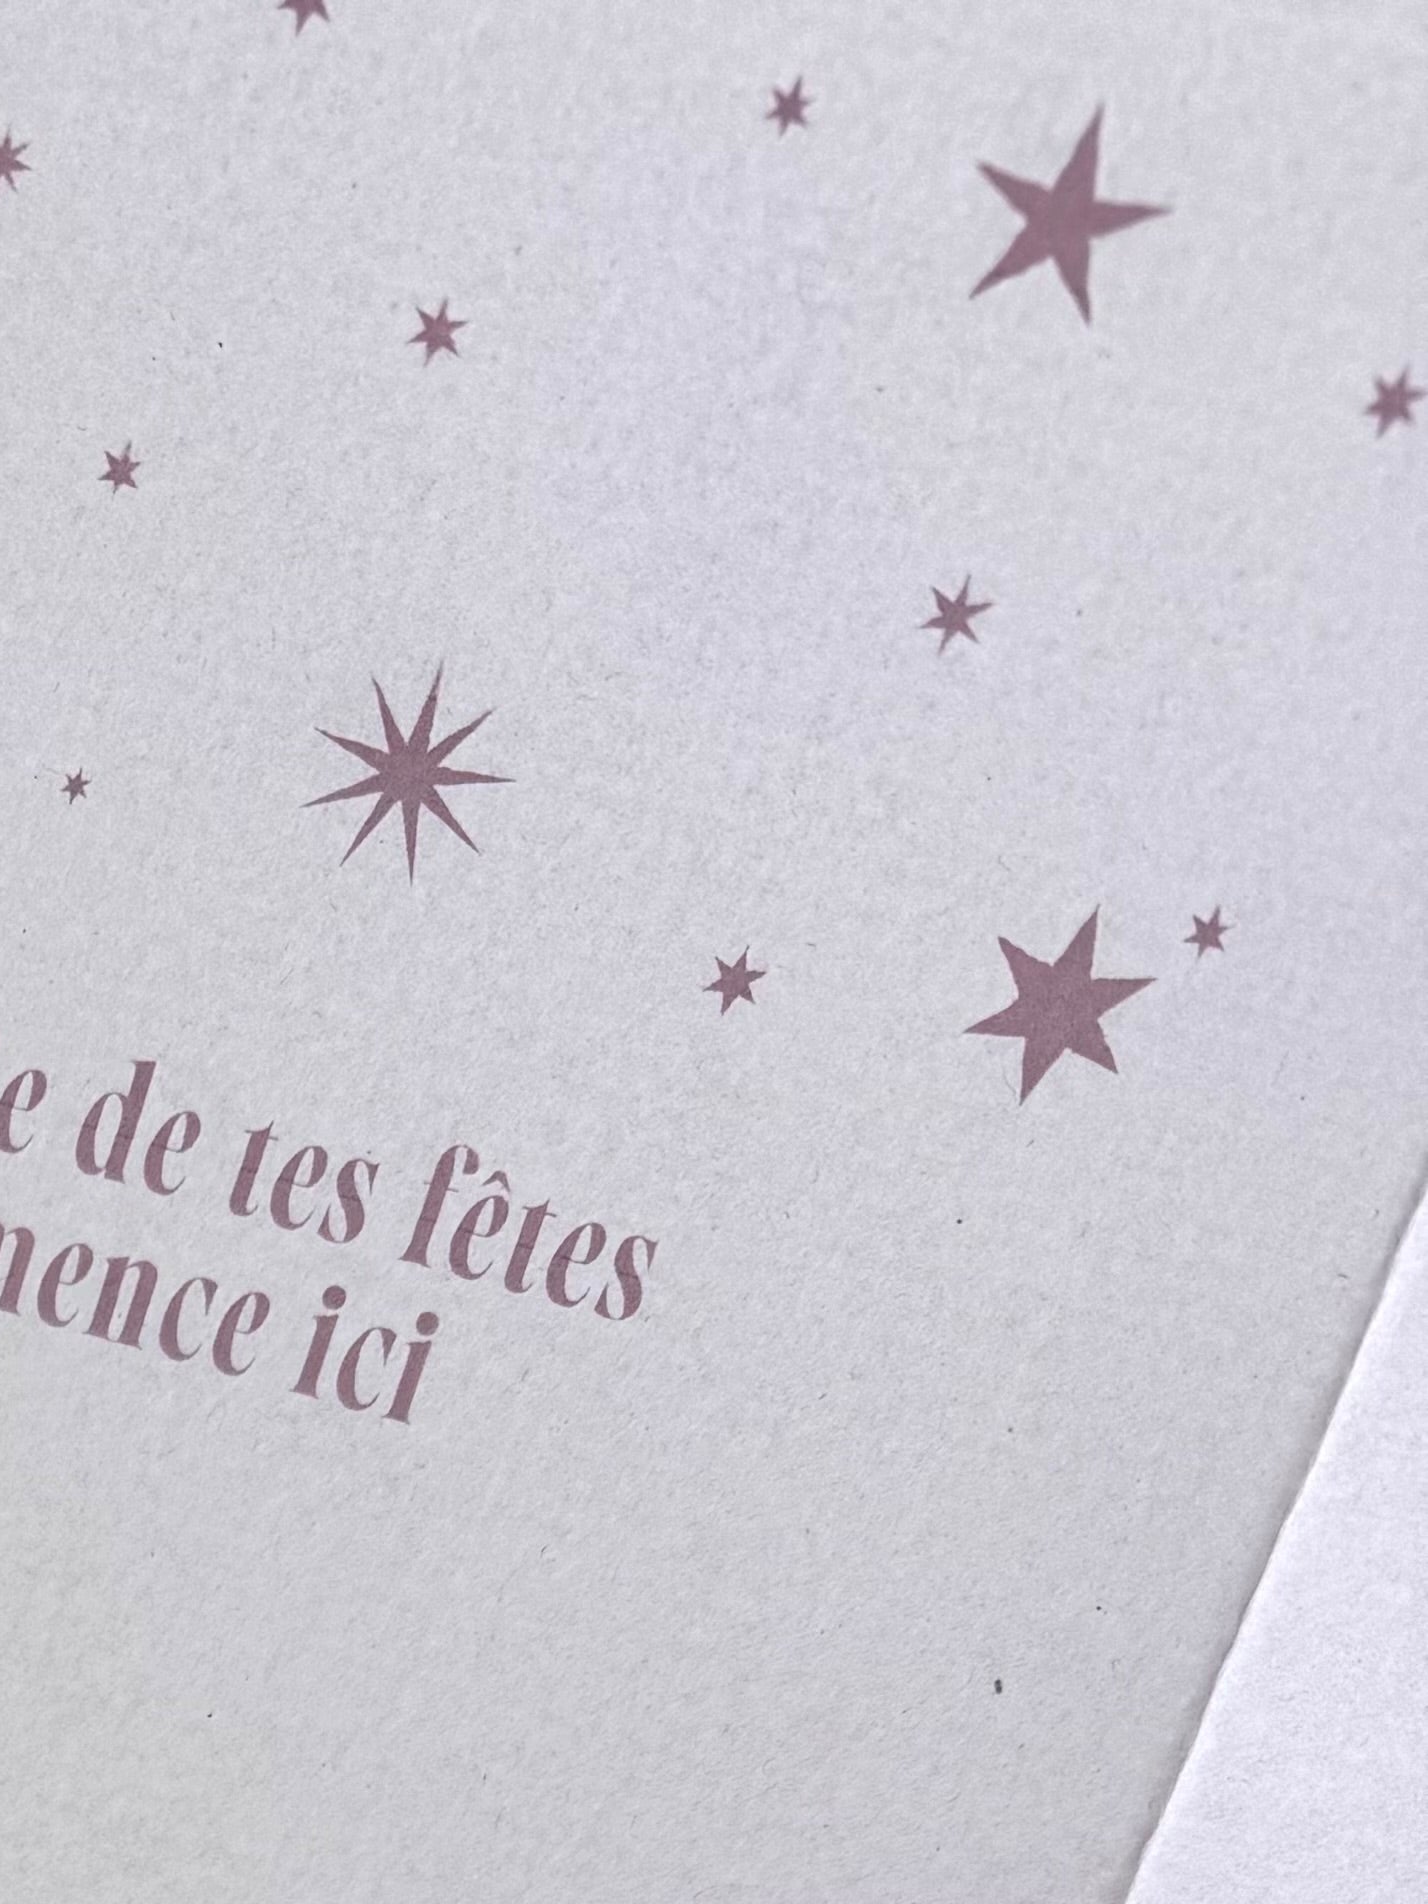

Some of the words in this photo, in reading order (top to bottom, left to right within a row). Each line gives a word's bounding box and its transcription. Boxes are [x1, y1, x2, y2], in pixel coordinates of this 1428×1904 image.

[76, 1061, 201, 1195] de
[229, 1121, 380, 1243] tes
[400, 1145, 658, 1320] fêtes
[291, 1285, 439, 1424] ici
